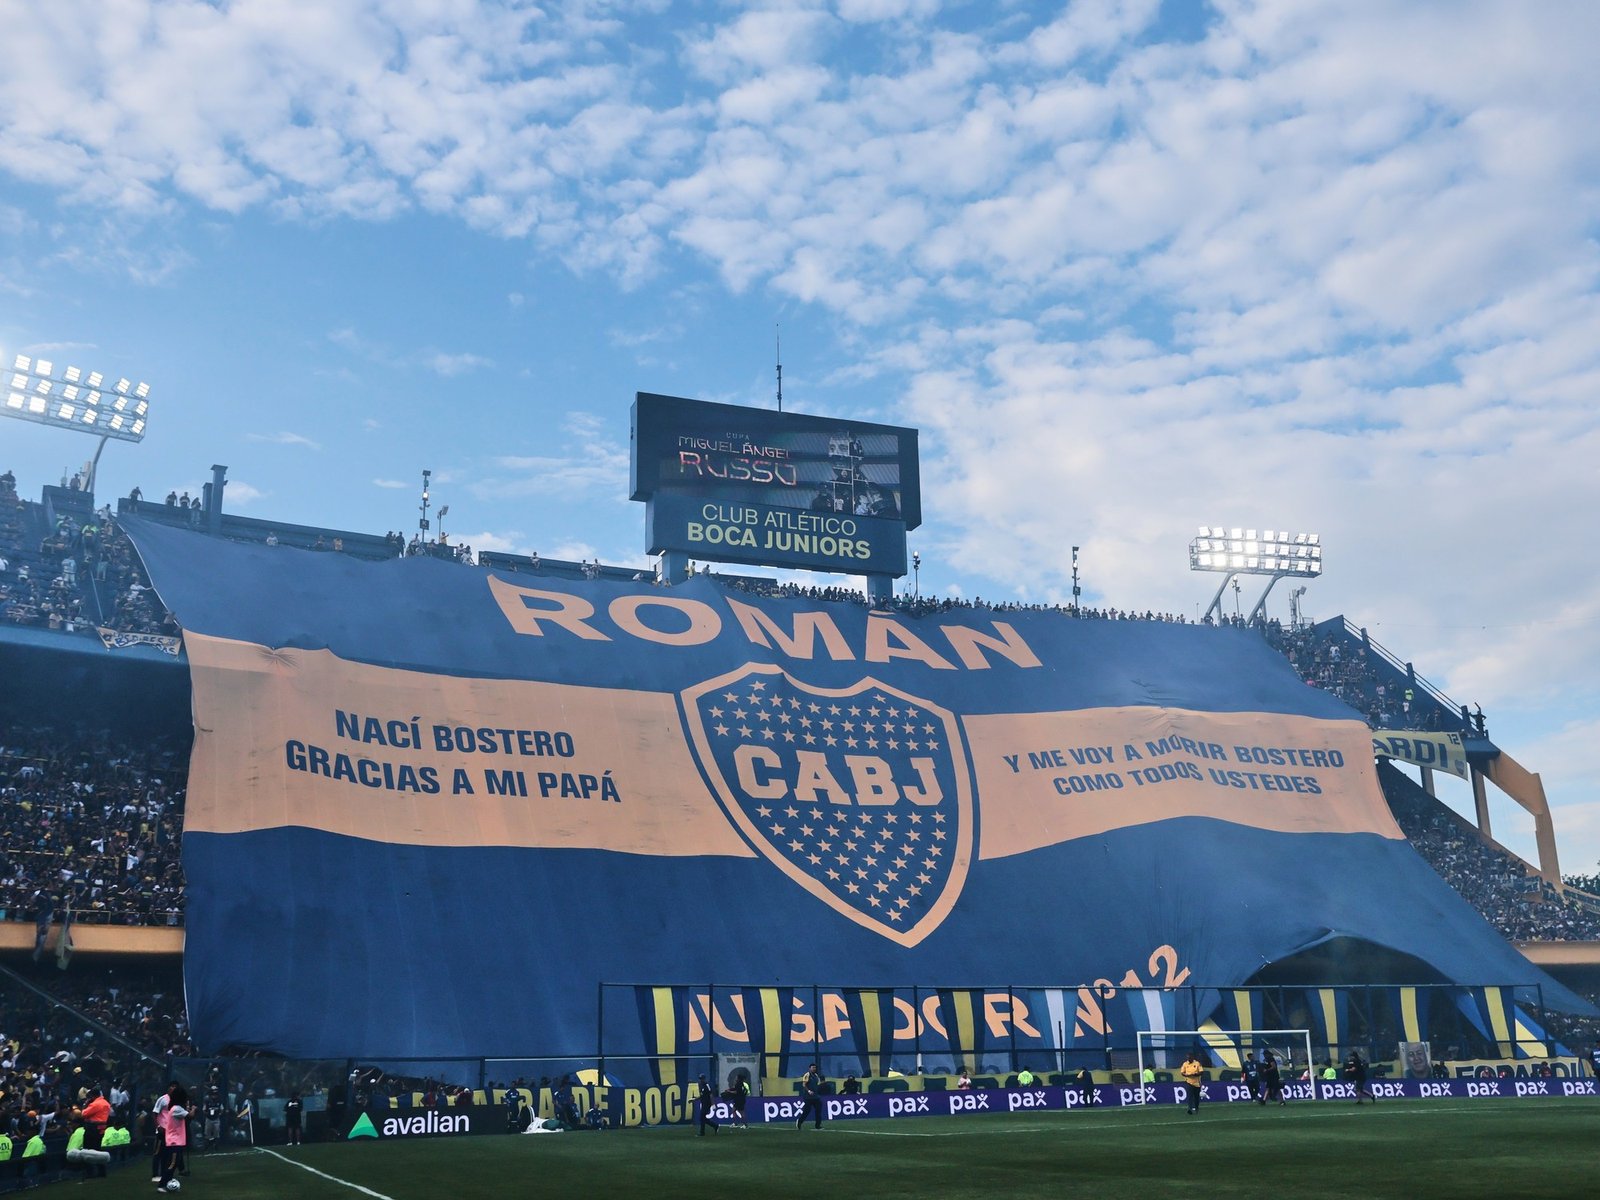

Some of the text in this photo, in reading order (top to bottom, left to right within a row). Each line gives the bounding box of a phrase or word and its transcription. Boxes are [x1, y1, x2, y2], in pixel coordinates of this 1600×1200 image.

[678, 436, 740, 454] MIGUEL
[679, 451, 797, 486] RUSSO
[702, 503, 857, 536] CLUB ATLÉTICO
[687, 522, 871, 560] BOCA JUNIORS
[487, 574, 1043, 671] ROMÁN
[335, 709, 576, 758] NACÍ BOSTERO
[1447, 733, 1460, 745] 12
[1002, 734, 1345, 773] Y ME VOY A MORIR BOSTERO
[285, 739, 622, 803] GRACIAS A MI PAPÁ
[733, 744, 944, 806] CABJ
[1053, 761, 1323, 795] COMO TODOS USTEDES
[1120, 1086, 1157, 1107] pax
[1321, 1082, 1357, 1100] pax
[1371, 1082, 1405, 1099] pax
[1420, 1081, 1453, 1098] pax
[1466, 1081, 1501, 1098] pax
[1515, 1080, 1549, 1097] pax
[1562, 1080, 1596, 1097] pax
[624, 1082, 700, 1127] BOCA
[764, 1100, 806, 1122] pax
[827, 1098, 868, 1120] pax
[888, 1095, 930, 1118] pax
[949, 1093, 990, 1115] pax
[1008, 1090, 1047, 1112] pax
[383, 1110, 470, 1136] avalian
